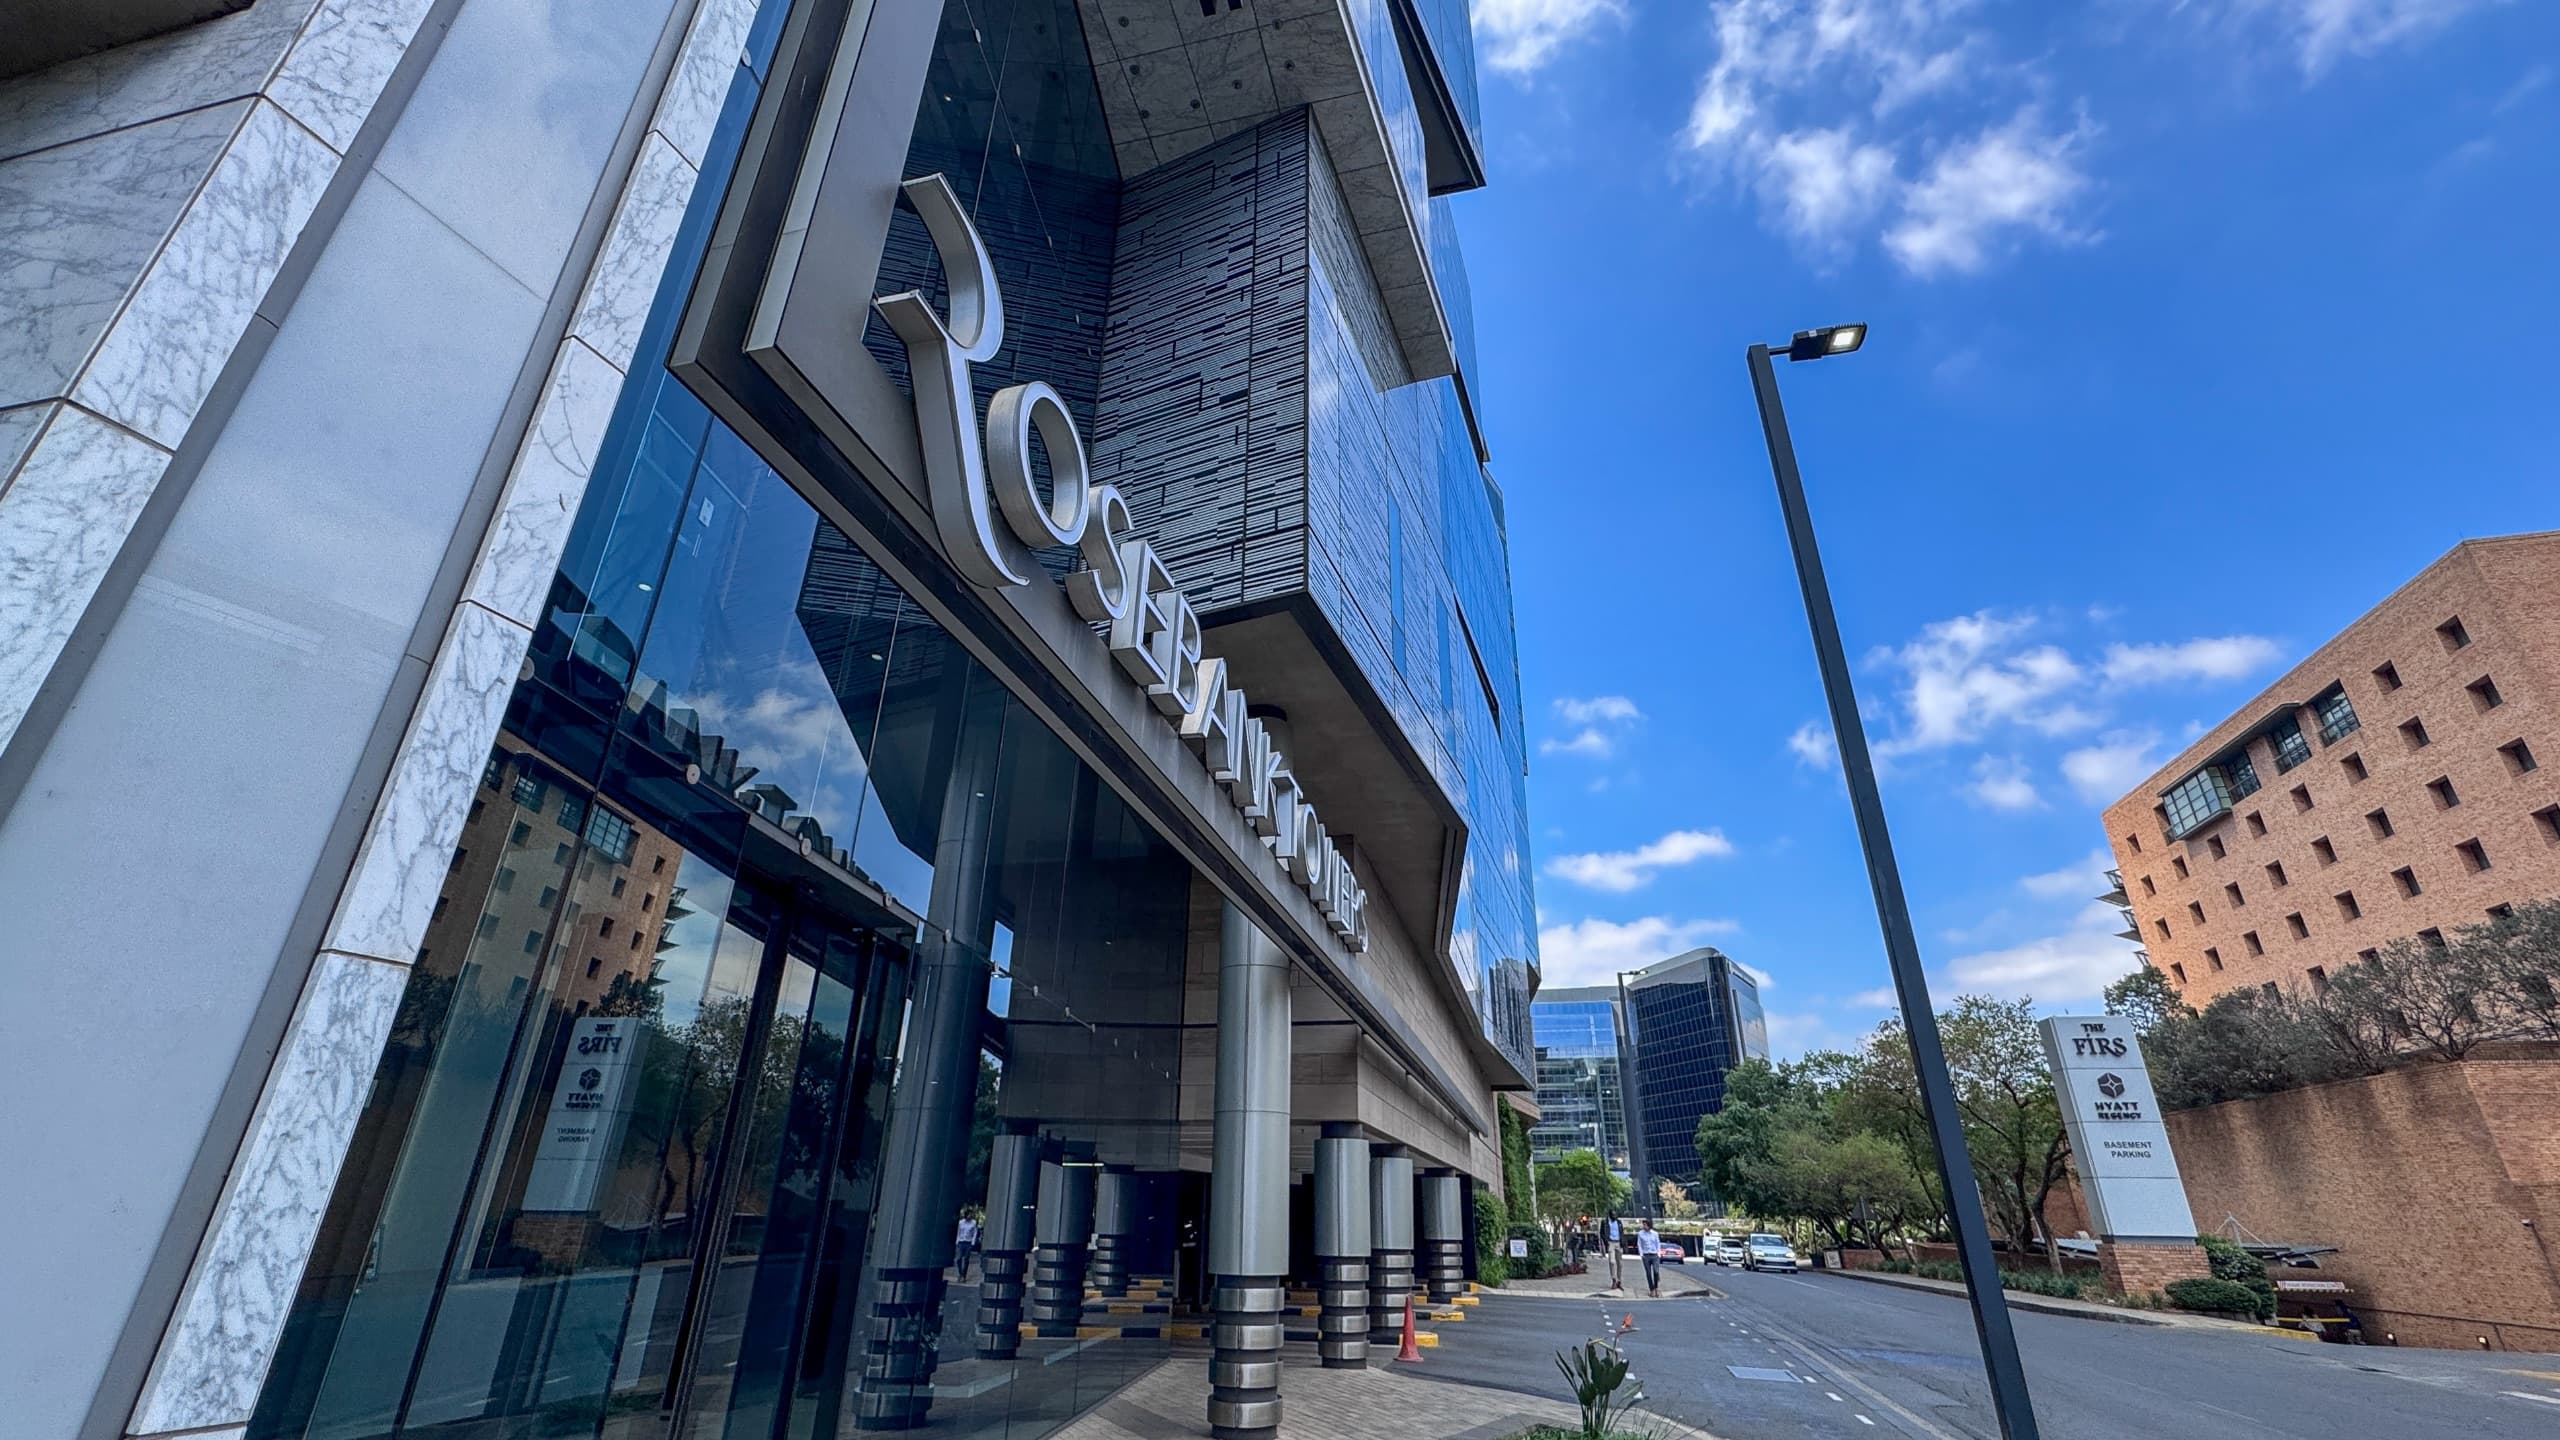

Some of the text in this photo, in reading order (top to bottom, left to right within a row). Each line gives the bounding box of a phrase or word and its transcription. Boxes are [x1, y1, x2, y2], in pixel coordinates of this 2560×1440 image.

[875, 172, 1368, 953] ROSEBANK TOWERS
[2080, 1023, 2106, 1033] THE
[2071, 1033, 2128, 1058] FIRS
[2094, 1101, 2139, 1111] HYATT
[2097, 1112, 2142, 1120] REGENCY
[2103, 1141, 2152, 1149] BASEMENT
[2111, 1150, 2152, 1158] PARKING
